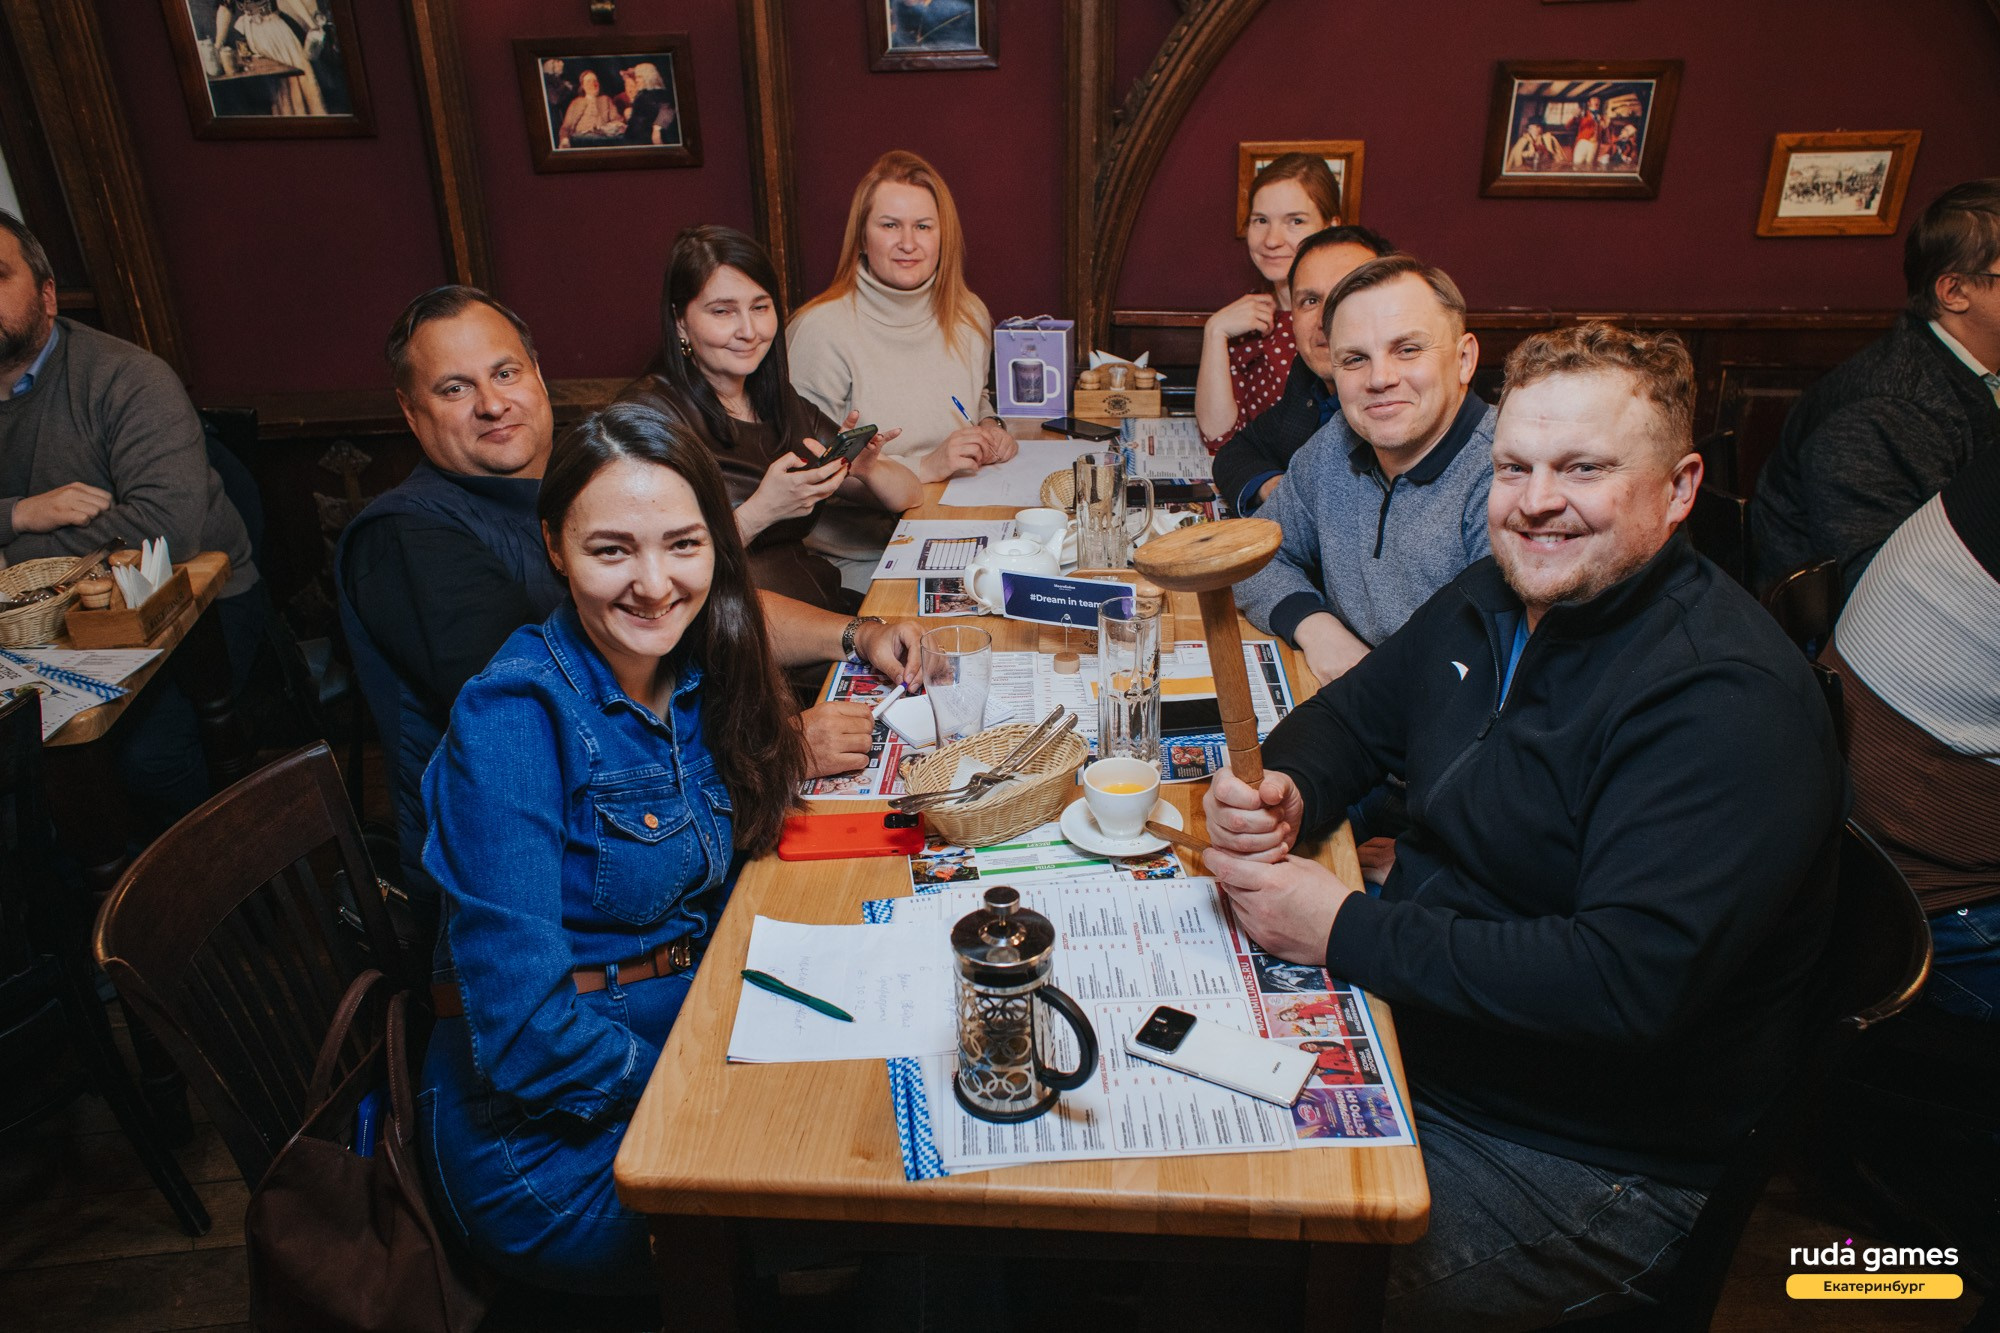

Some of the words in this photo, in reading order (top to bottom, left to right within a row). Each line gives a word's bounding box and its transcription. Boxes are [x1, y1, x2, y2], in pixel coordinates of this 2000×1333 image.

[1029, 593, 1066, 604] #Dream
[1067, 597, 1076, 605] in
[1078, 599, 1101, 608] team
[1240, 961, 1265, 1030] MAXIMILIANS.RU
[1333, 1003, 1342, 1017] МАРТА
[1344, 1007, 1353, 1021] ДЕНЬ
[1346, 997, 1362, 1030] ИМЕНИННИКА
[1347, 1050, 1356, 1065] МАРТА
[1358, 1051, 1369, 1070] БОЖЬЯ
[1364, 1047, 1377, 1073] КОРОВКА
[1334, 1090, 1355, 1135] ВЕЧЕРИНКА
[1366, 1096, 1377, 1115] МАРТА
[1349, 1103, 1368, 1135] РЕТРО
